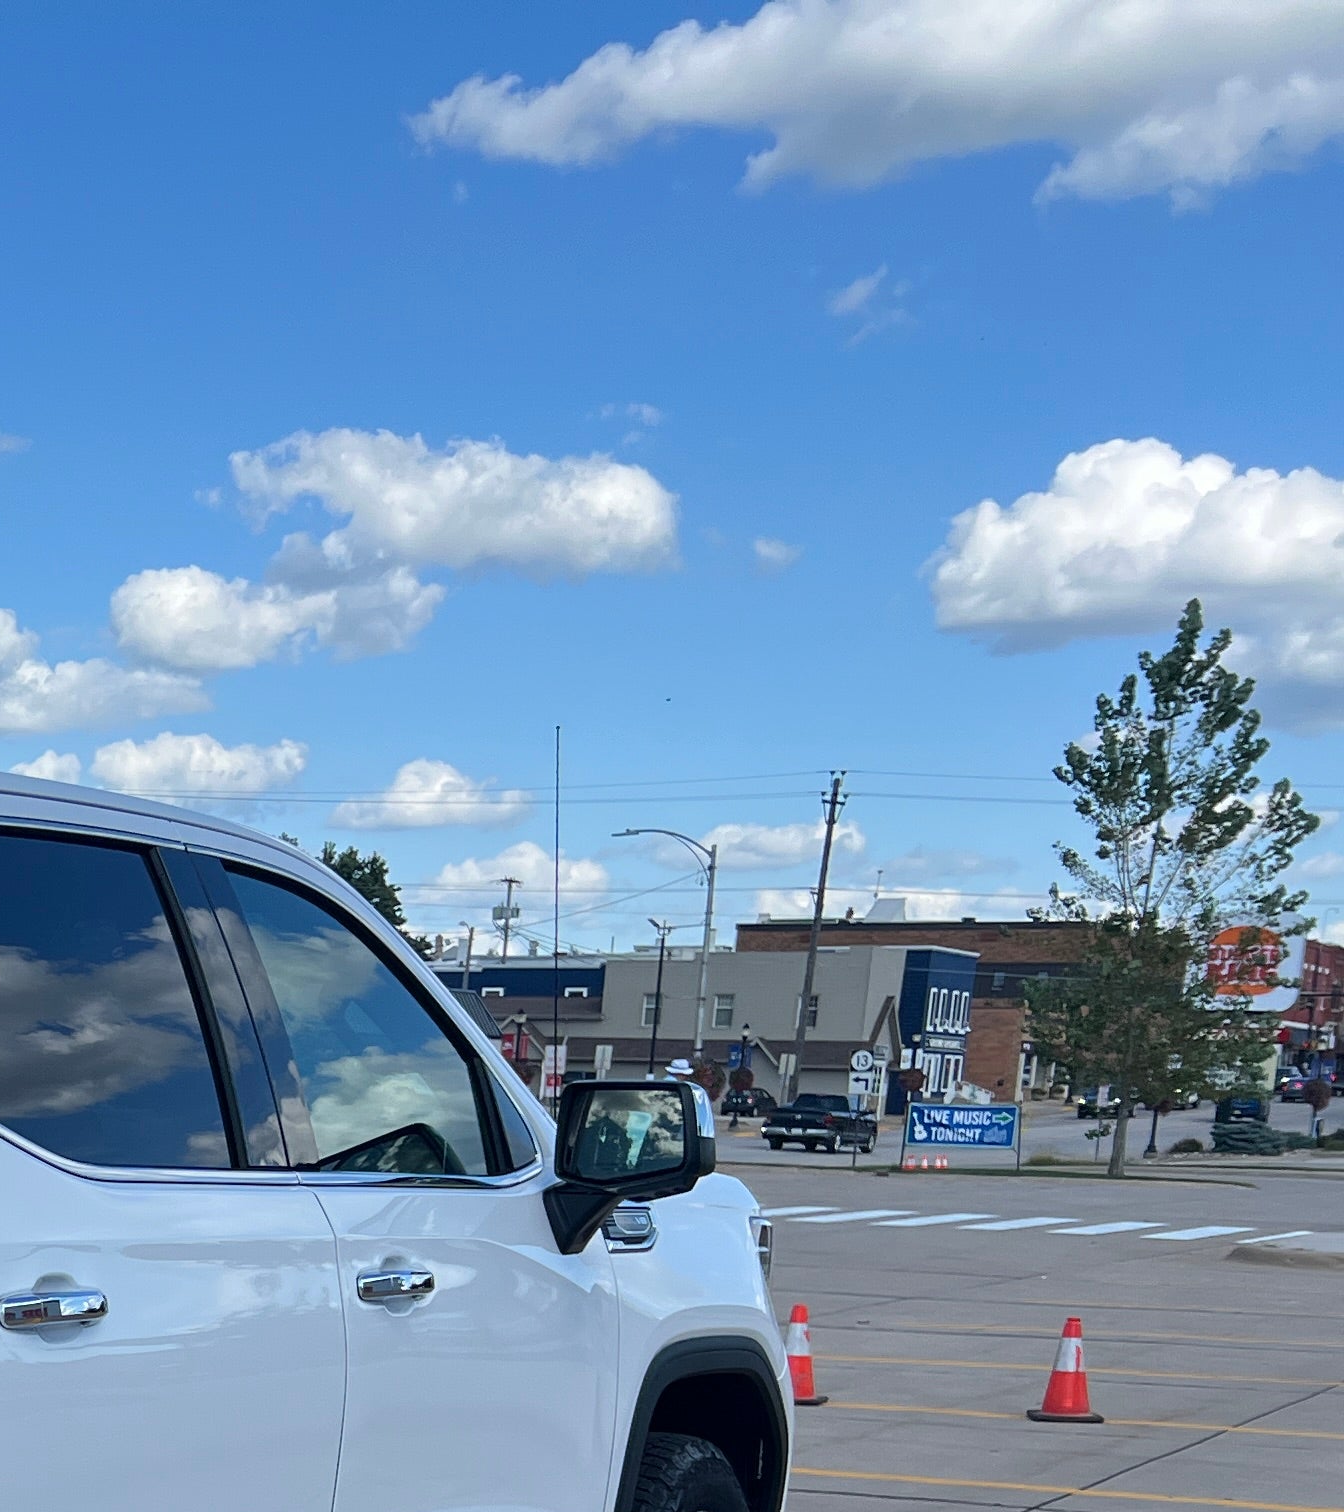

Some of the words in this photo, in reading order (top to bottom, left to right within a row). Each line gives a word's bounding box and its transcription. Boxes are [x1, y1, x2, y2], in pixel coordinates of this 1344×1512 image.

[856, 1054, 869, 1068] 13
[923, 1109, 950, 1124] LIVE
[953, 1110, 992, 1126] MUSIC
[930, 1126, 982, 1143] TONIGHT
